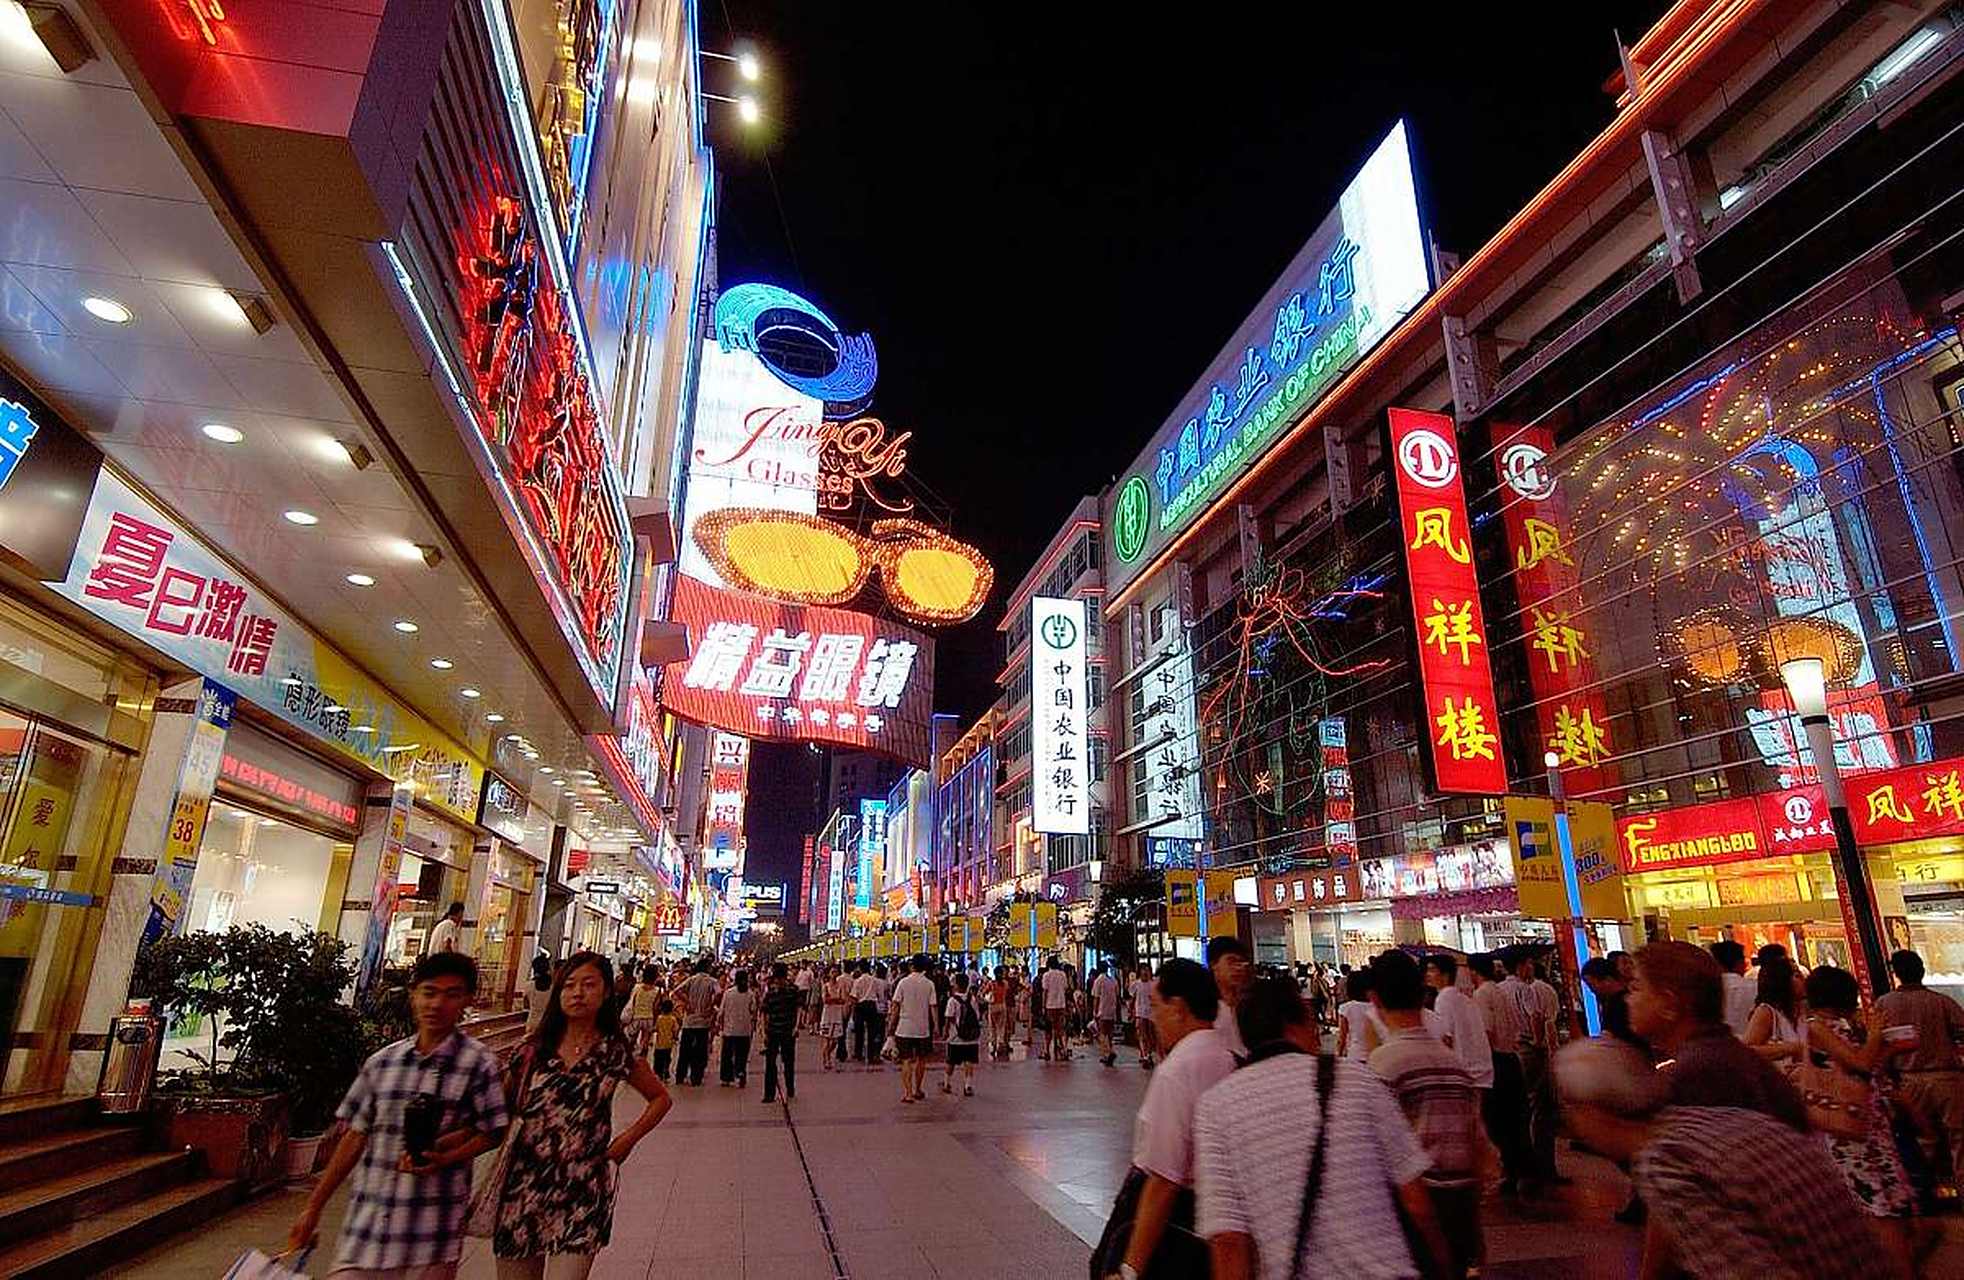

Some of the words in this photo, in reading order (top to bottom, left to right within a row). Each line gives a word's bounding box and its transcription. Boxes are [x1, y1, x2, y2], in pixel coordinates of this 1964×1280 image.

[695, 405, 839, 467] Jing
[1156, 237, 1360, 503] 中国农业银行
[1242, 388, 1286, 446] BANK
[1285, 363, 1311, 402] OF
[1310, 305, 1374, 375] CHINA
[747, 457, 854, 495] Glasses
[84, 511, 278, 676] 夏日激情
[1410, 507, 1498, 761] 凤祥楼
[682, 620, 919, 709] 精益眼镜
[1051, 658, 1078, 817] 中国农业银行
[173, 819, 194, 842] 38
